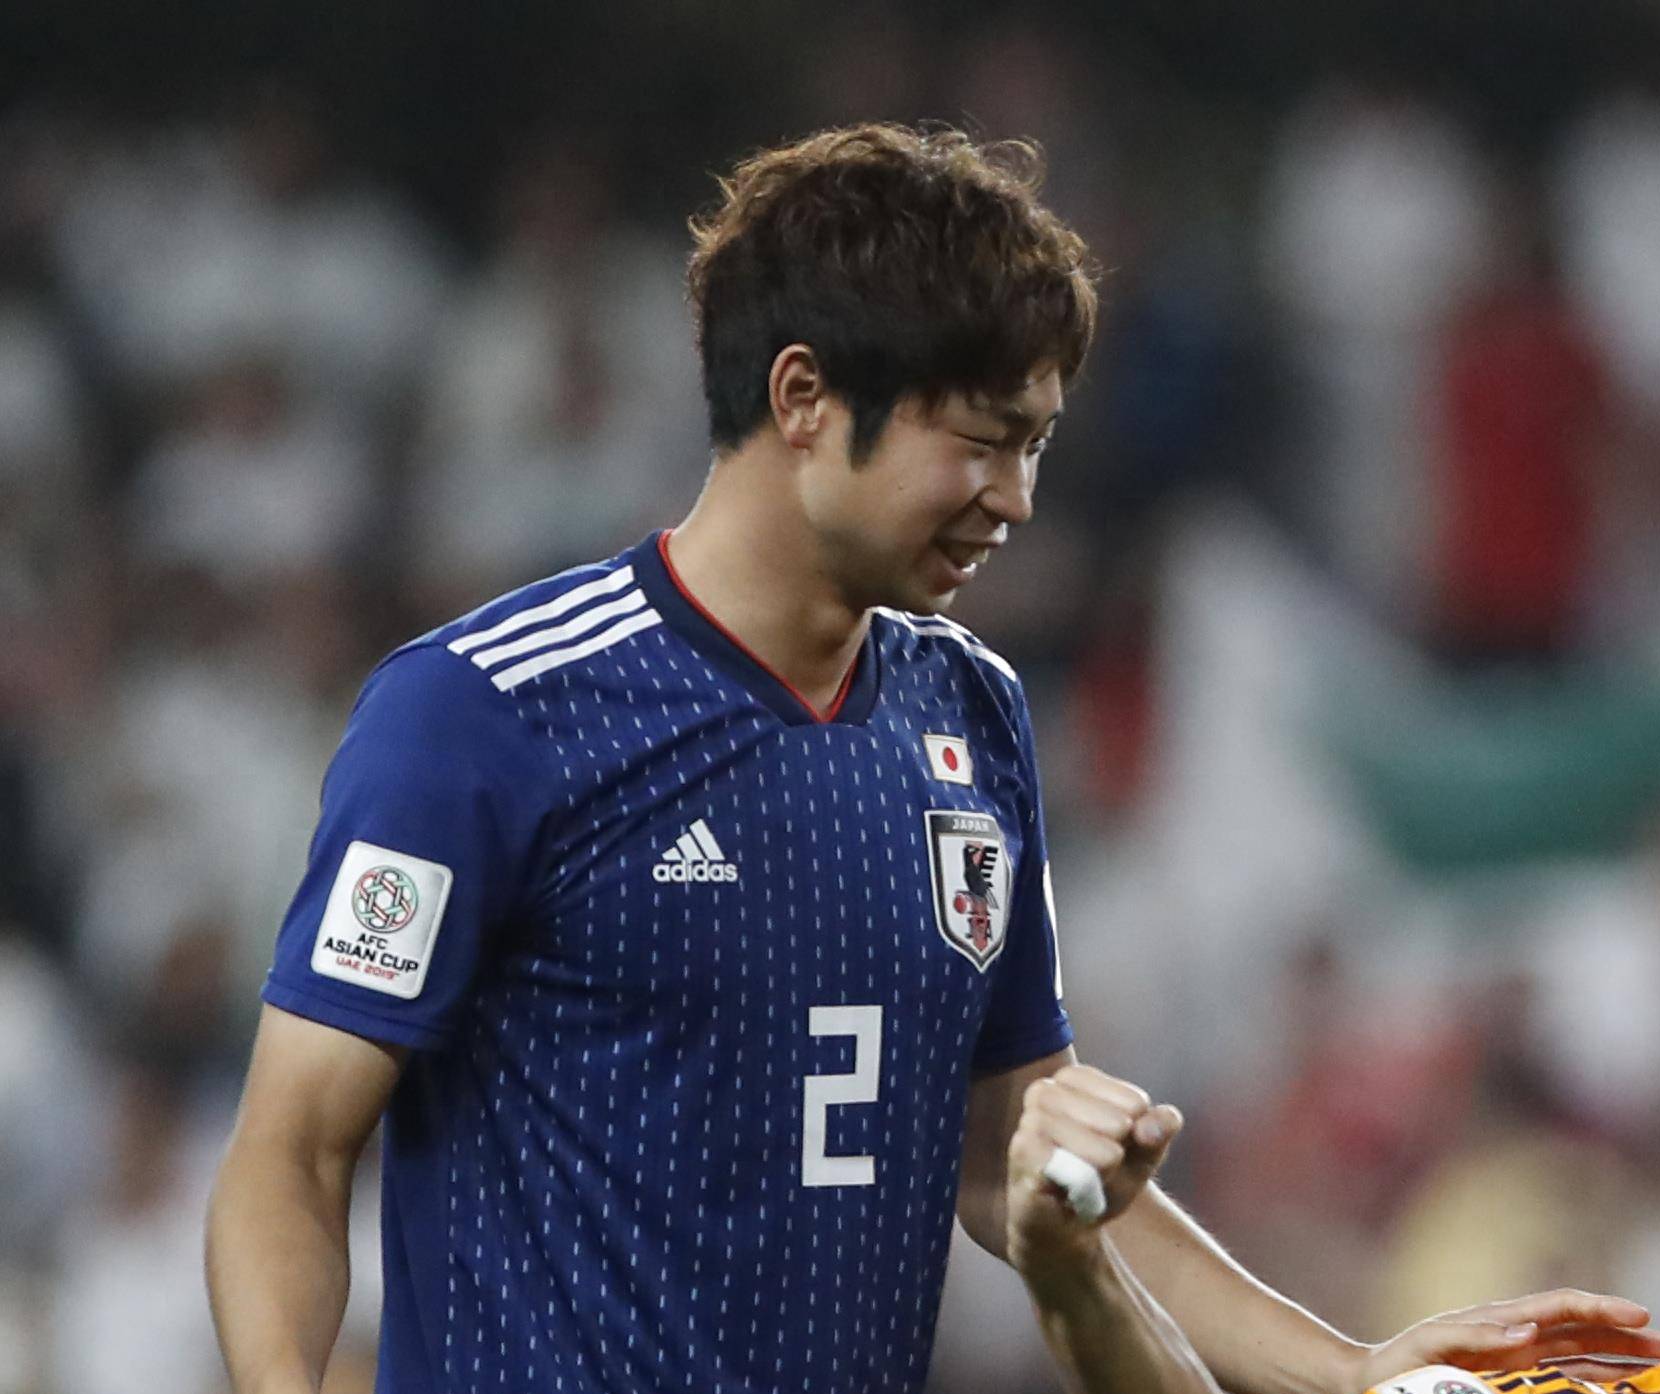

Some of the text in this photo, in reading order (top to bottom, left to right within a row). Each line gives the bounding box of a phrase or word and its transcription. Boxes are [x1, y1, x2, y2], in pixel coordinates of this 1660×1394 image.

[952, 818, 989, 832] JAPAN
[652, 858, 738, 882] adidas
[357, 933, 388, 950] AFC
[323, 937, 419, 973] ASIAN CUP
[802, 1005, 883, 1187] 2
